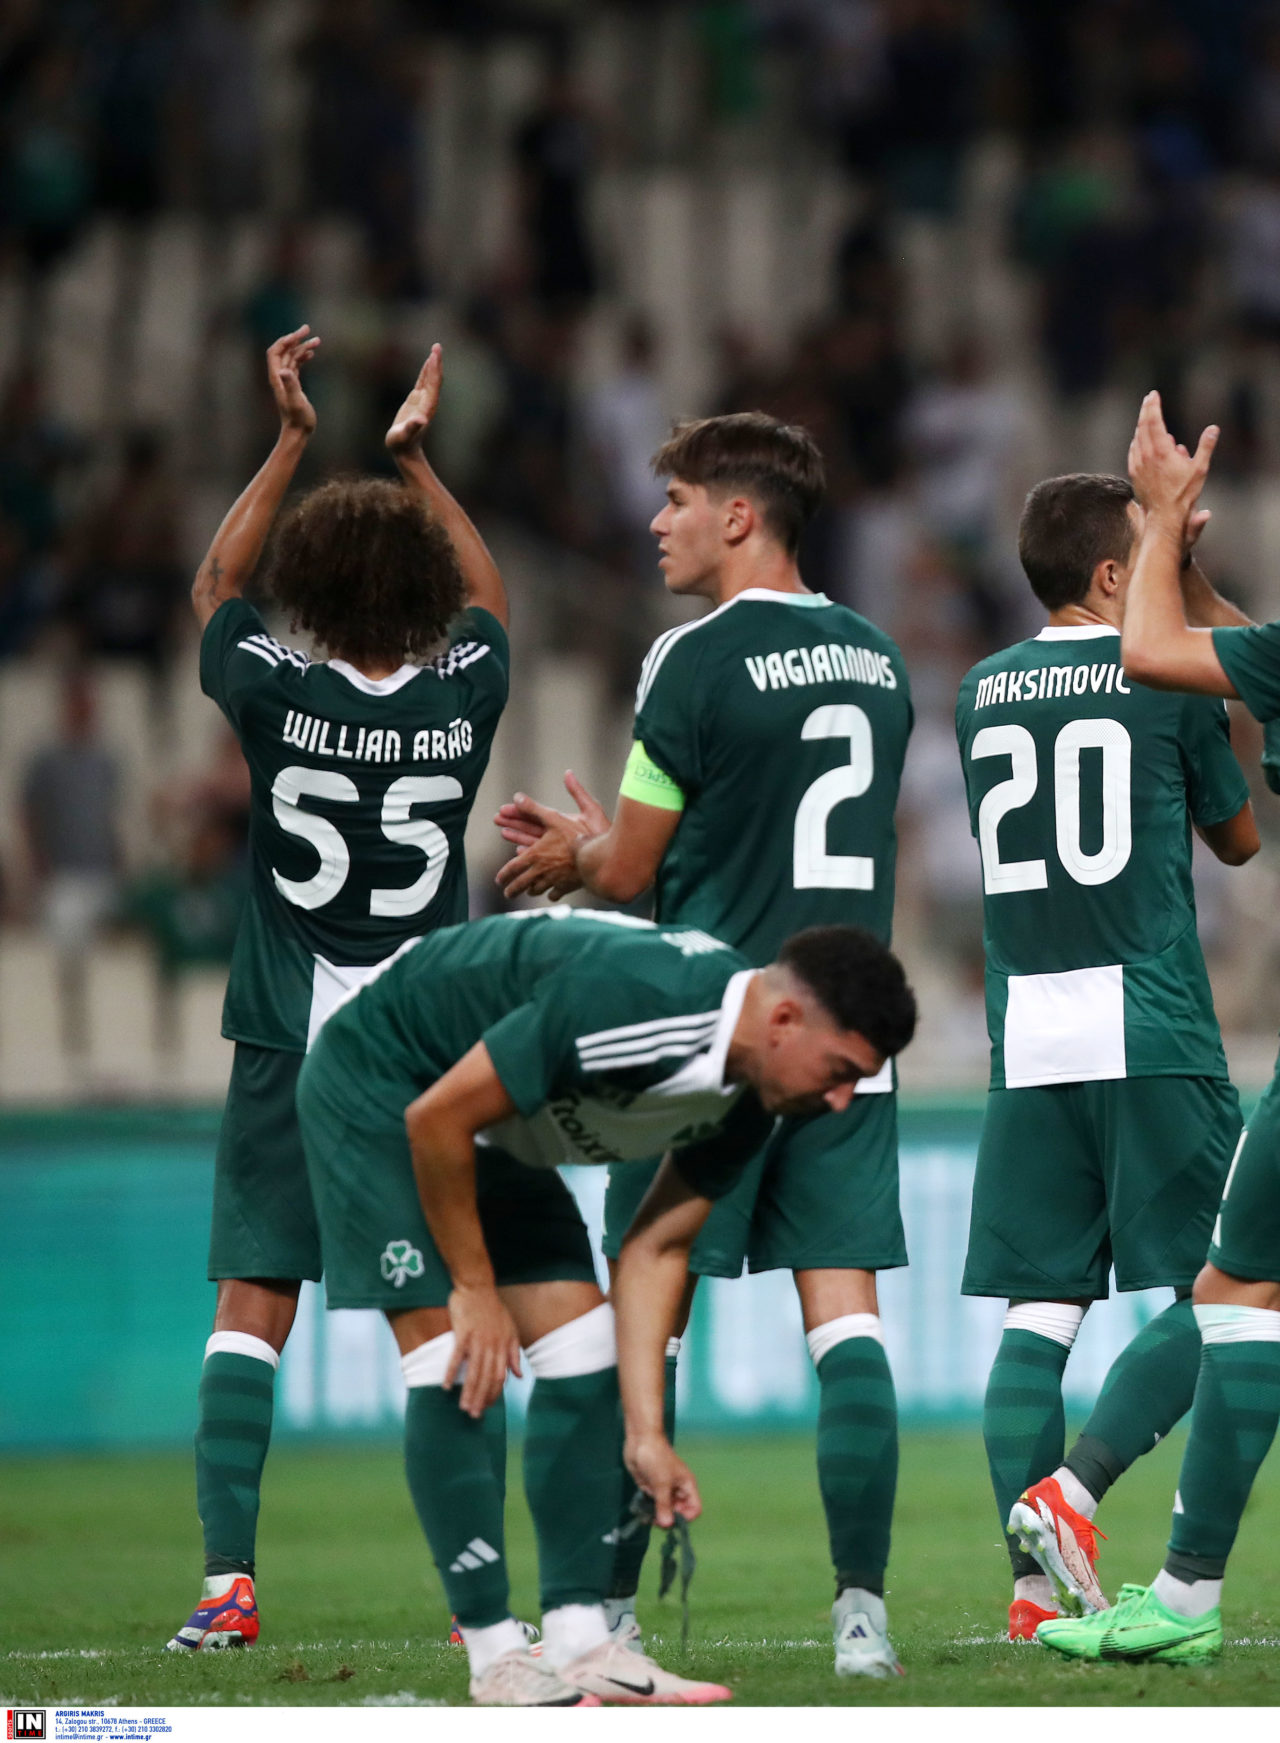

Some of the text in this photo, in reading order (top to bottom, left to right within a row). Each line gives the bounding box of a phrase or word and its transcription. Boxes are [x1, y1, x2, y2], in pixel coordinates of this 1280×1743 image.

[283, 709, 473, 763] WILLIAN ARÃO
[744, 643, 897, 692] VAGIANNIDIS
[271, 766, 463, 917] 55
[793, 704, 874, 890] 2
[971, 718, 1132, 895] 20
